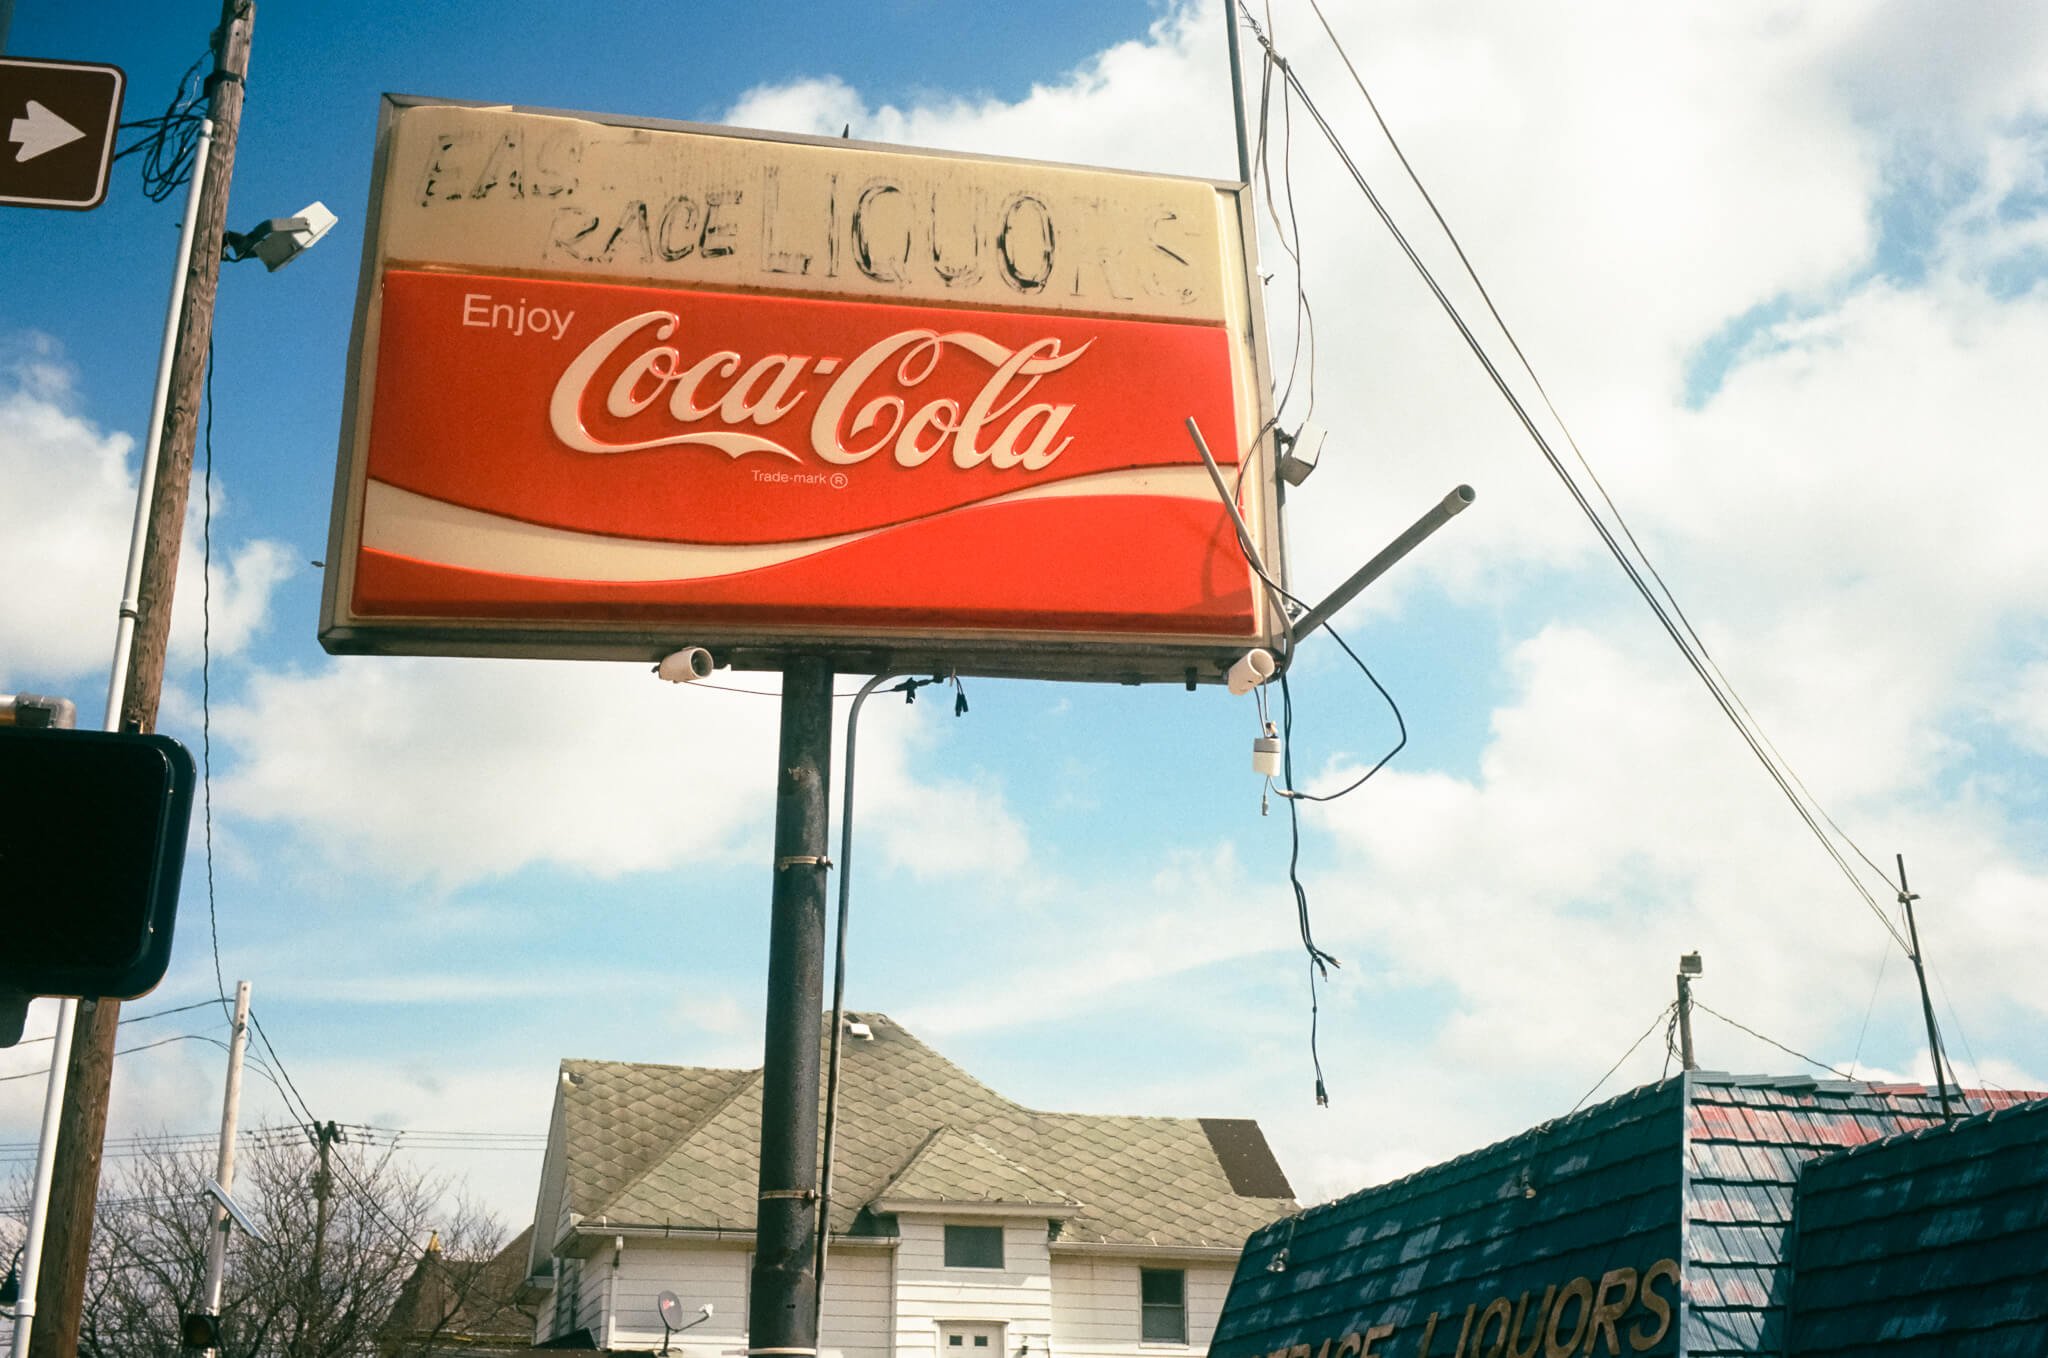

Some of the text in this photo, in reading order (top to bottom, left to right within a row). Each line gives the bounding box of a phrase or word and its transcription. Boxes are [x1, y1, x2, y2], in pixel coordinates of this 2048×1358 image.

[461, 293, 576, 341] Enjoy
[549, 310, 1098, 471] Coca-Cola
[751, 469, 827, 484] Trade-mark
